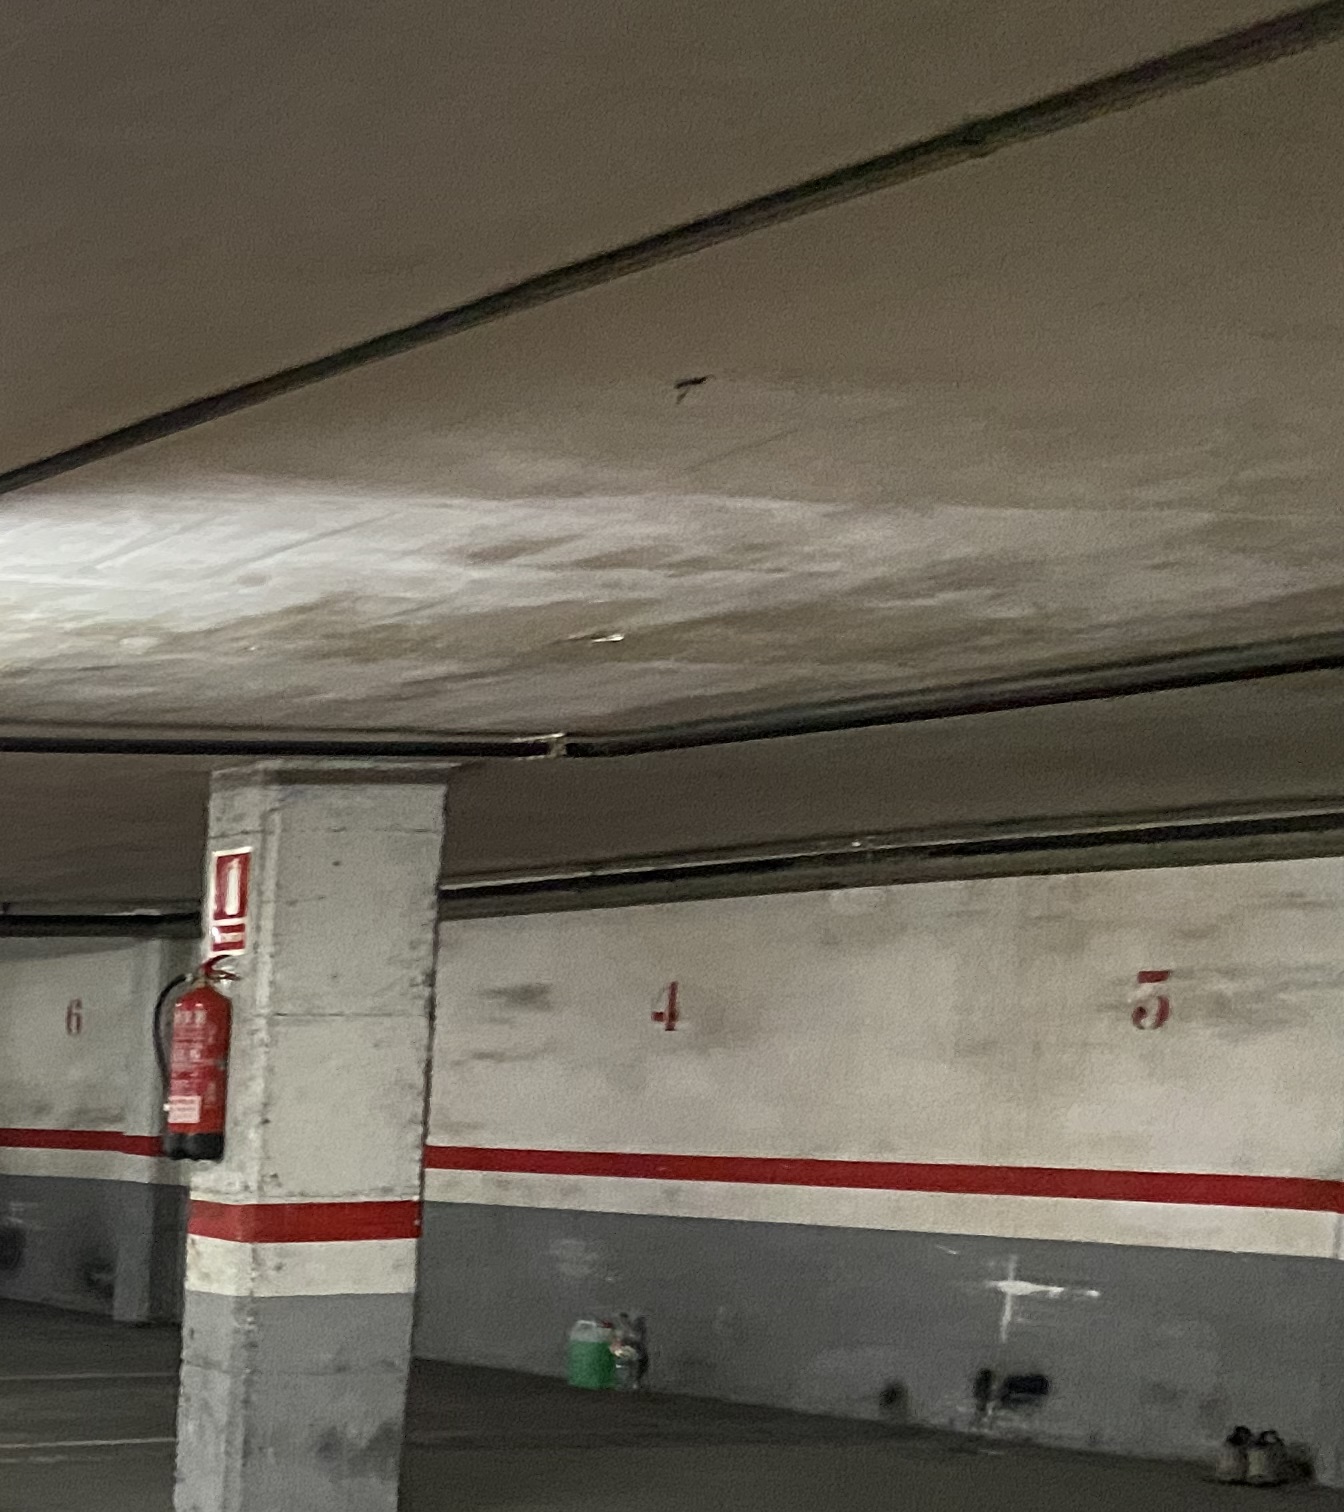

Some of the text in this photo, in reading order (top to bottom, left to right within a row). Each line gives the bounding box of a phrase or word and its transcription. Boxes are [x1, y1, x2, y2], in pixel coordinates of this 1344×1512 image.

[65, 998, 82, 1036] 6
[651, 981, 680, 1028] 4
[1132, 970, 1171, 1030] 5
